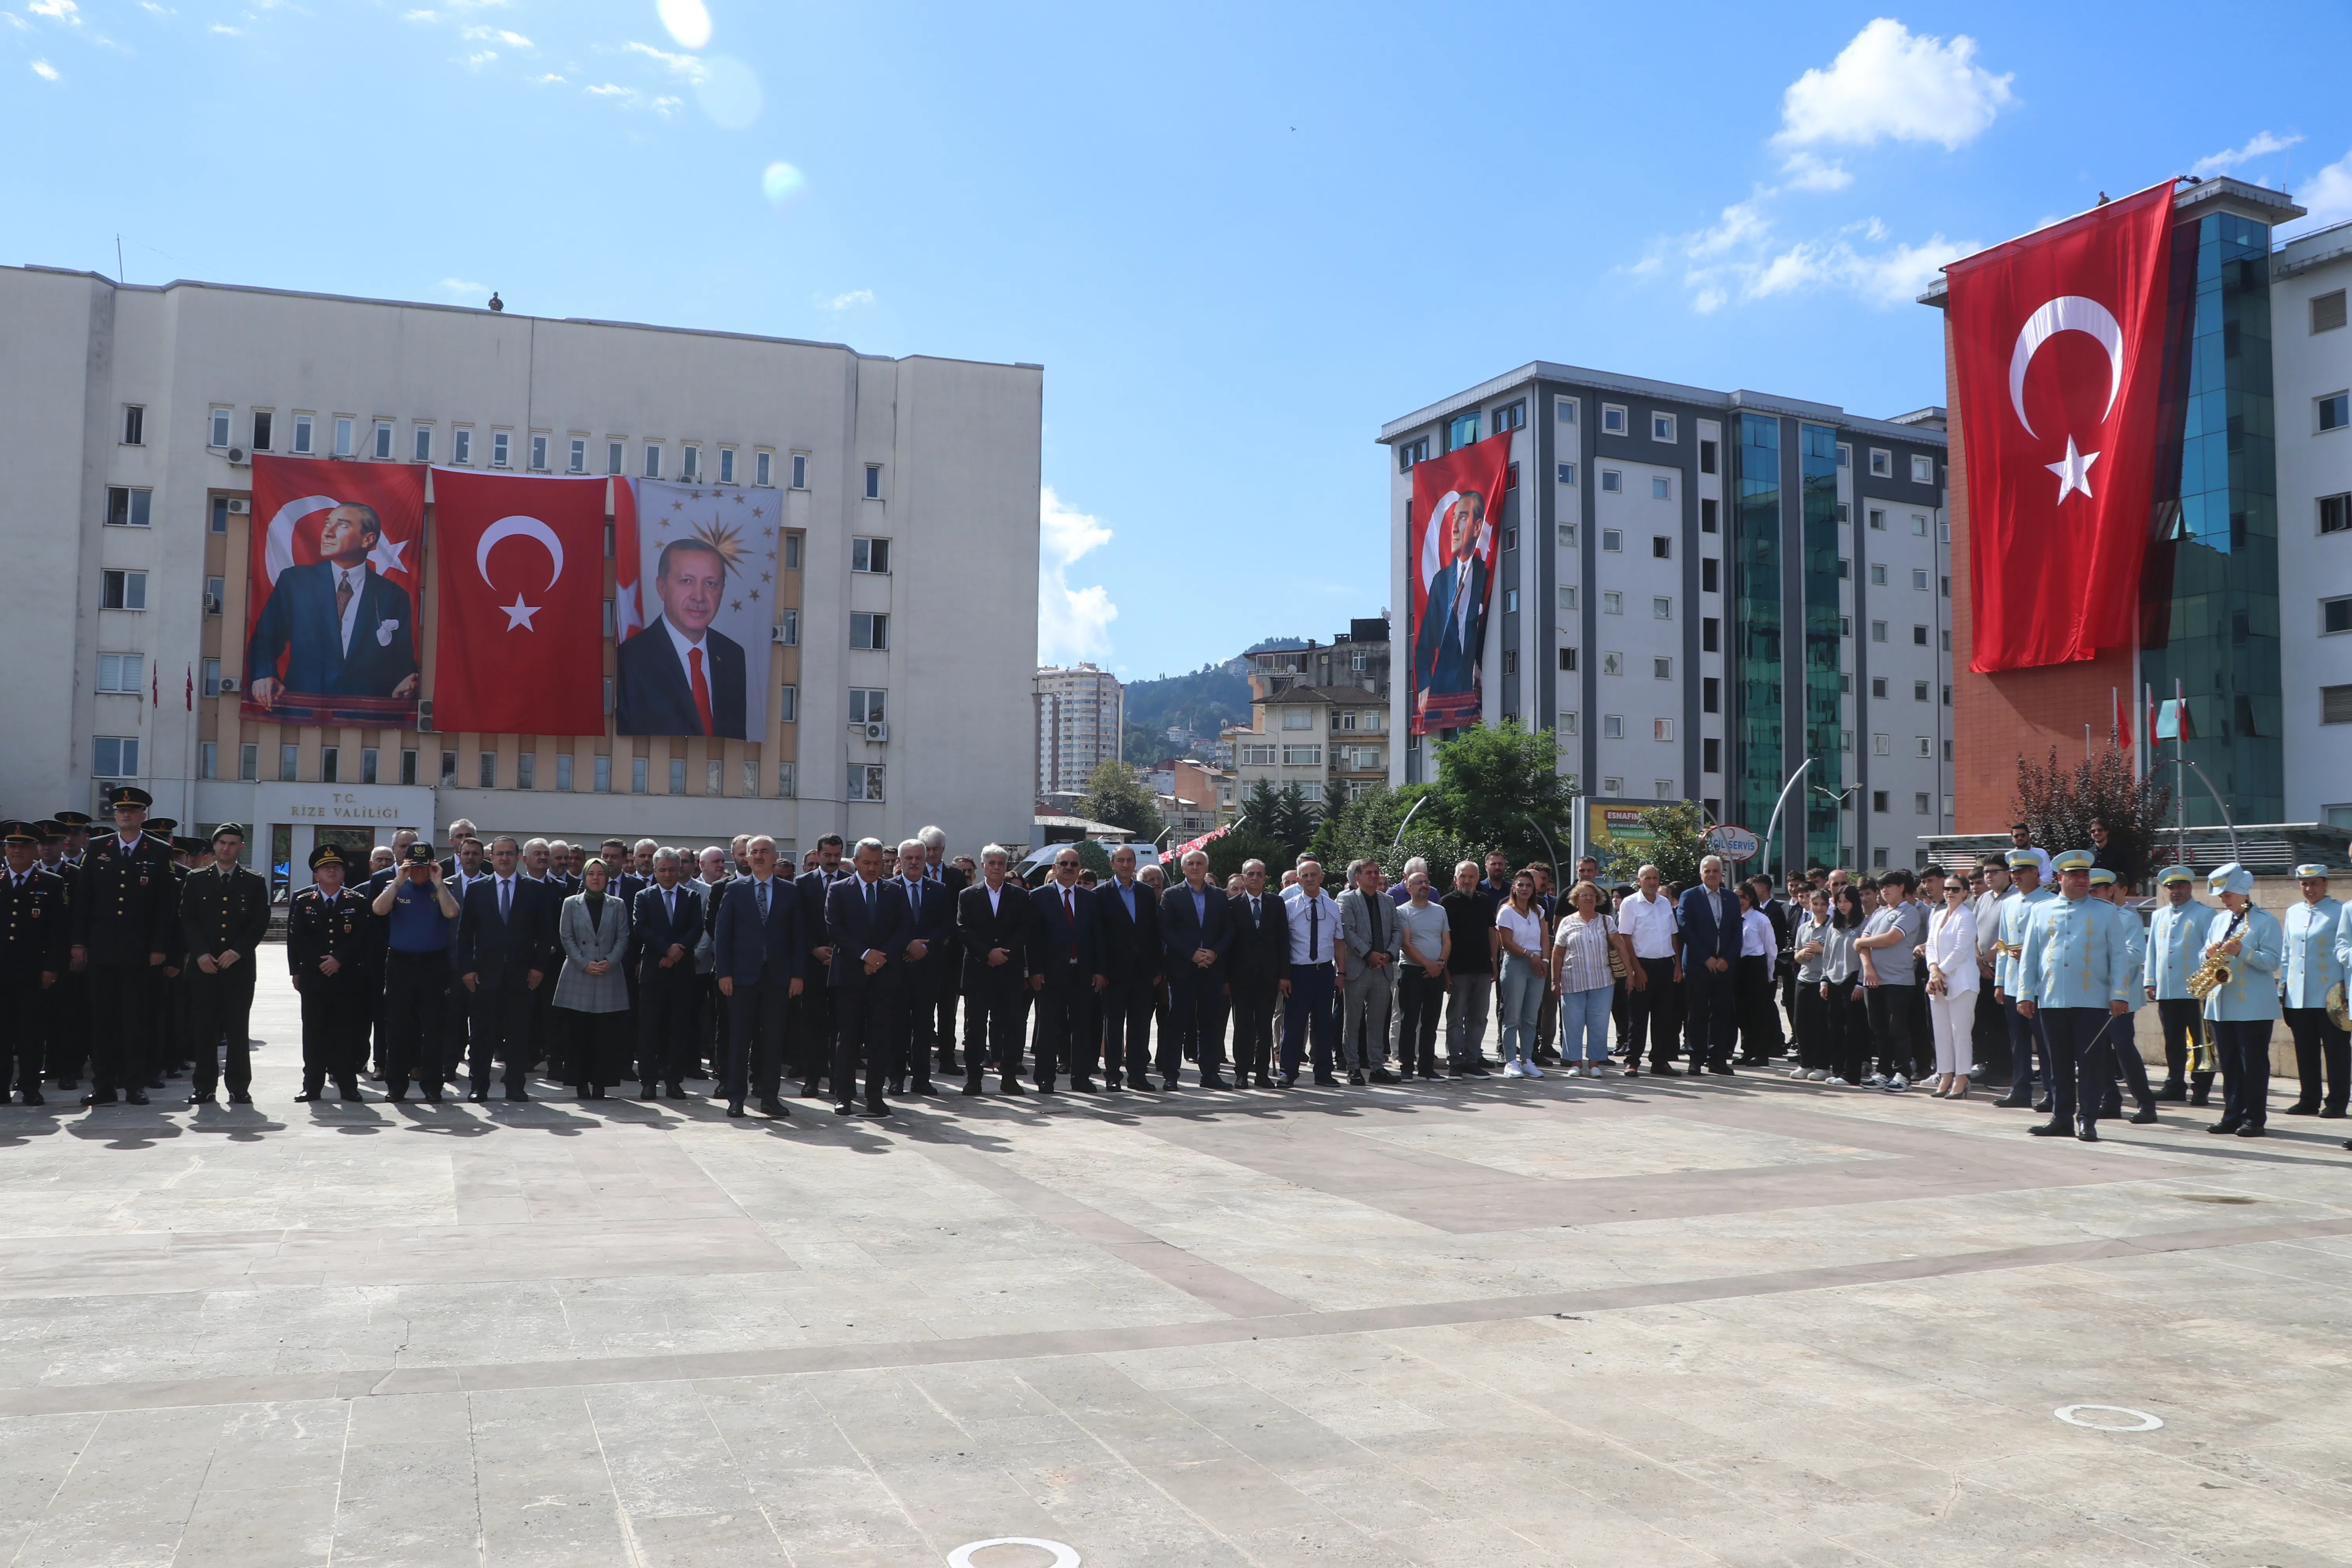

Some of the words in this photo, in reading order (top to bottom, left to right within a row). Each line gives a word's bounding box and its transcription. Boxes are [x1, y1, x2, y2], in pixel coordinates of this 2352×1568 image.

[333, 793, 356, 803] T.C.
[291, 804, 325, 816] RİZE
[333, 806, 398, 818] VALİLİĞİ
[1728, 840, 1755, 850] SERVİS
